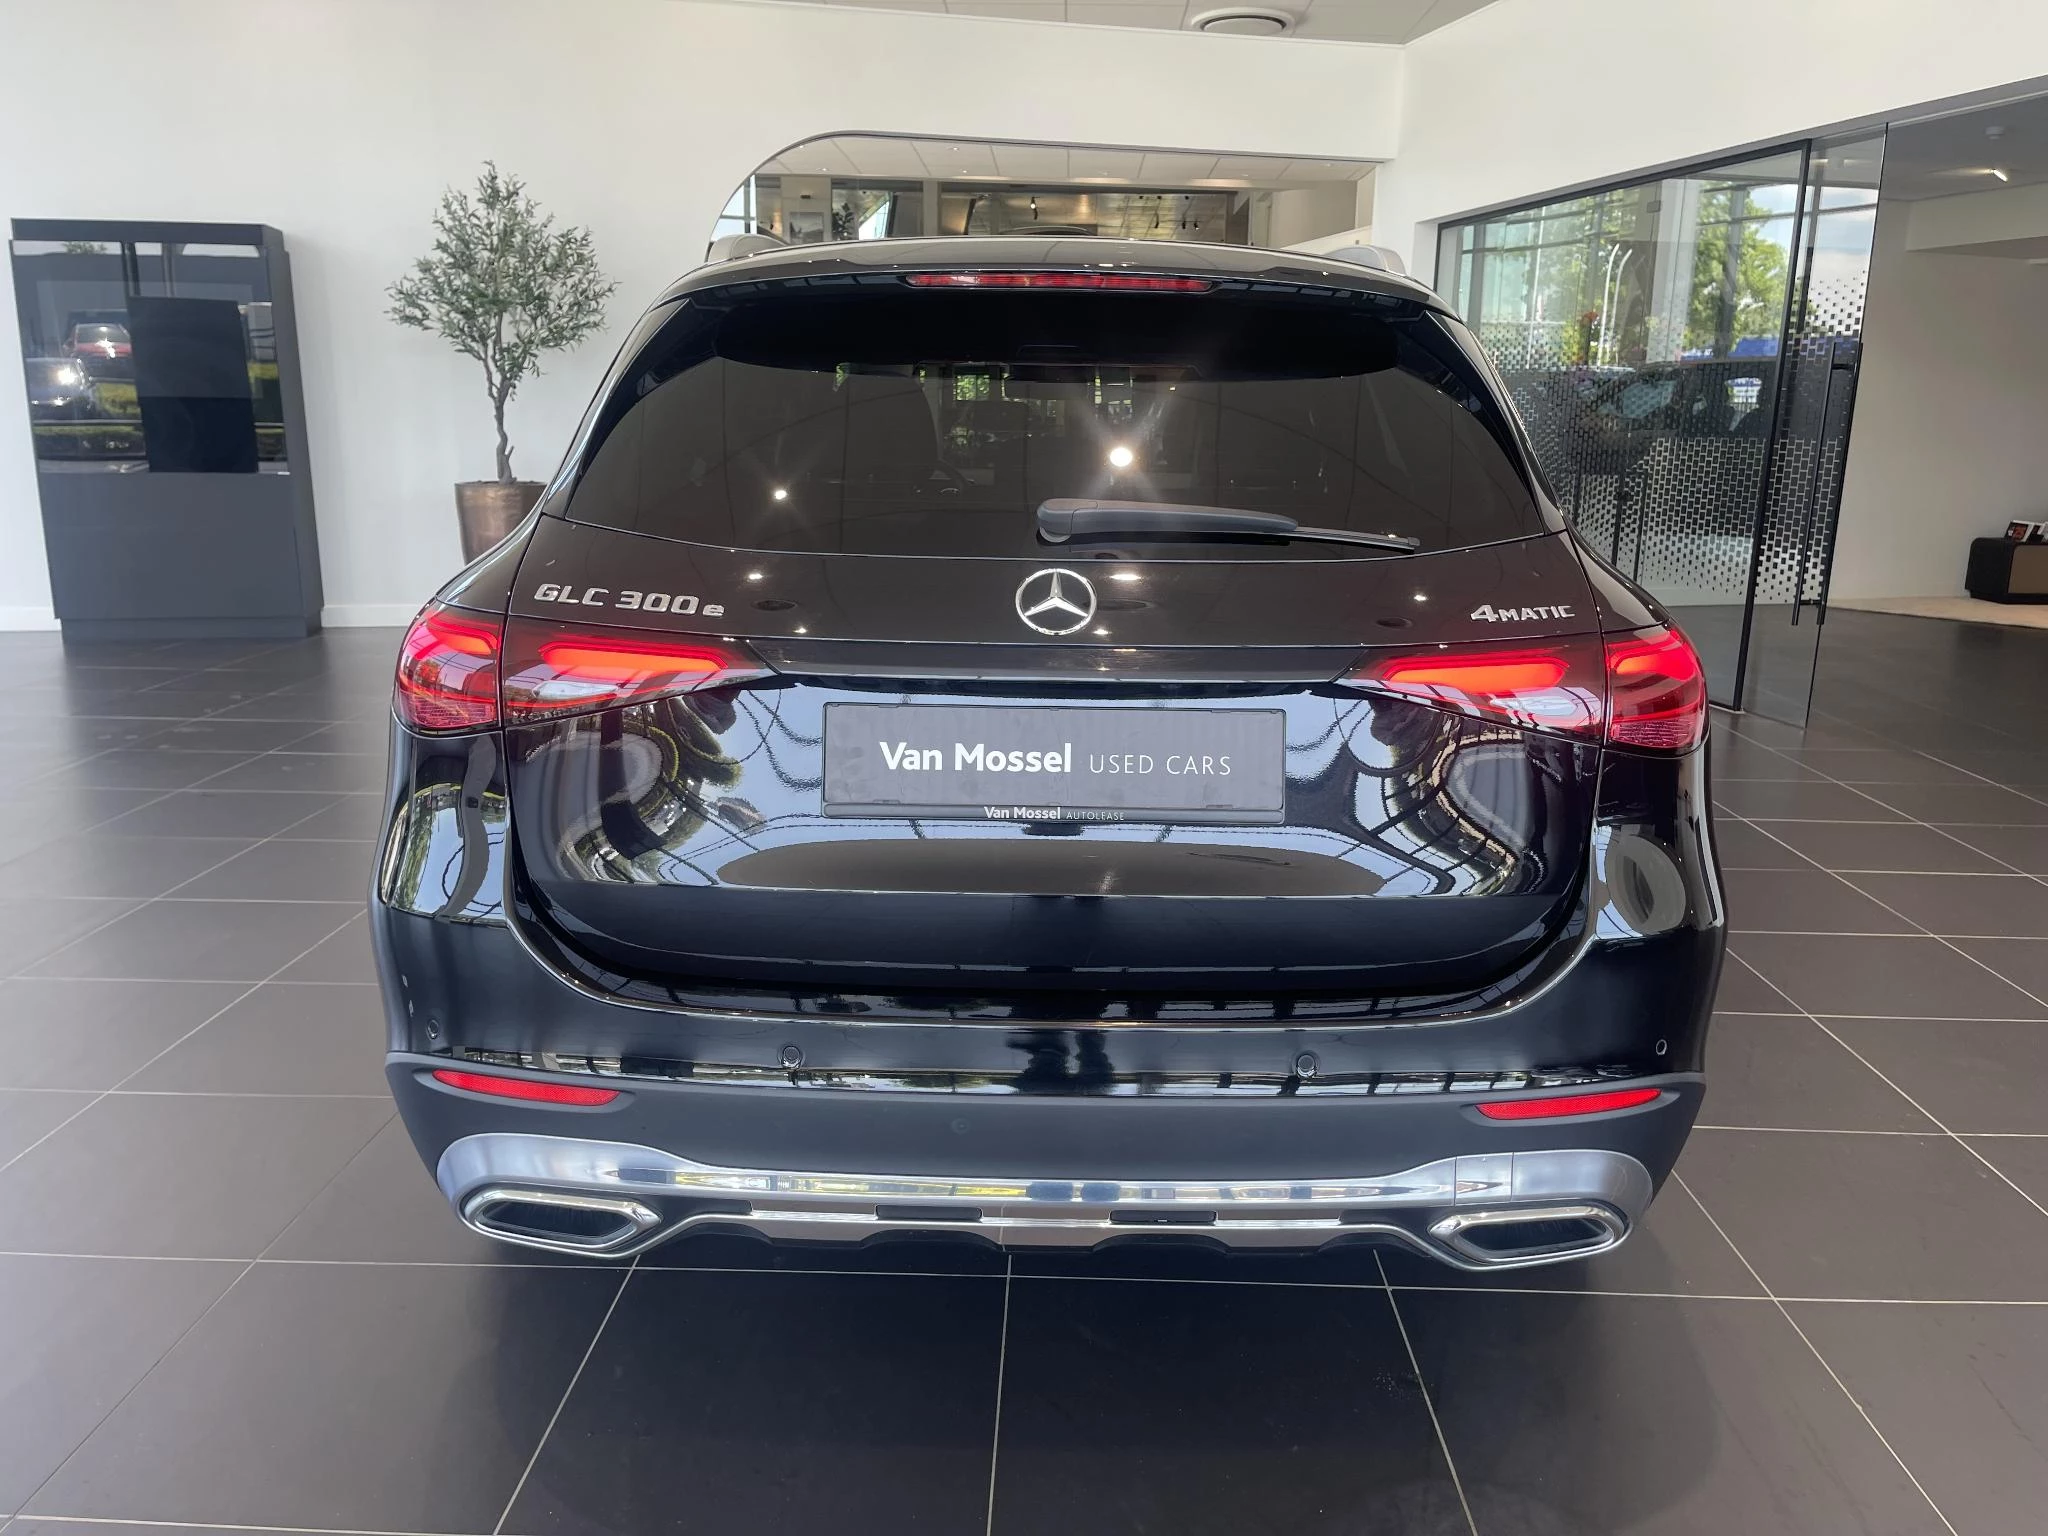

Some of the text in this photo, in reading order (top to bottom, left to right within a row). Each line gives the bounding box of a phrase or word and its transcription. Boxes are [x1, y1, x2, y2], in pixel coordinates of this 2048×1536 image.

[534, 583, 609, 606] GLC
[1470, 604, 1576, 623] 4MATIC
[879, 741, 1232, 776] Van Mossel USED CARS
[984, 806, 1125, 821] Van Mossel AUTOLEASE
